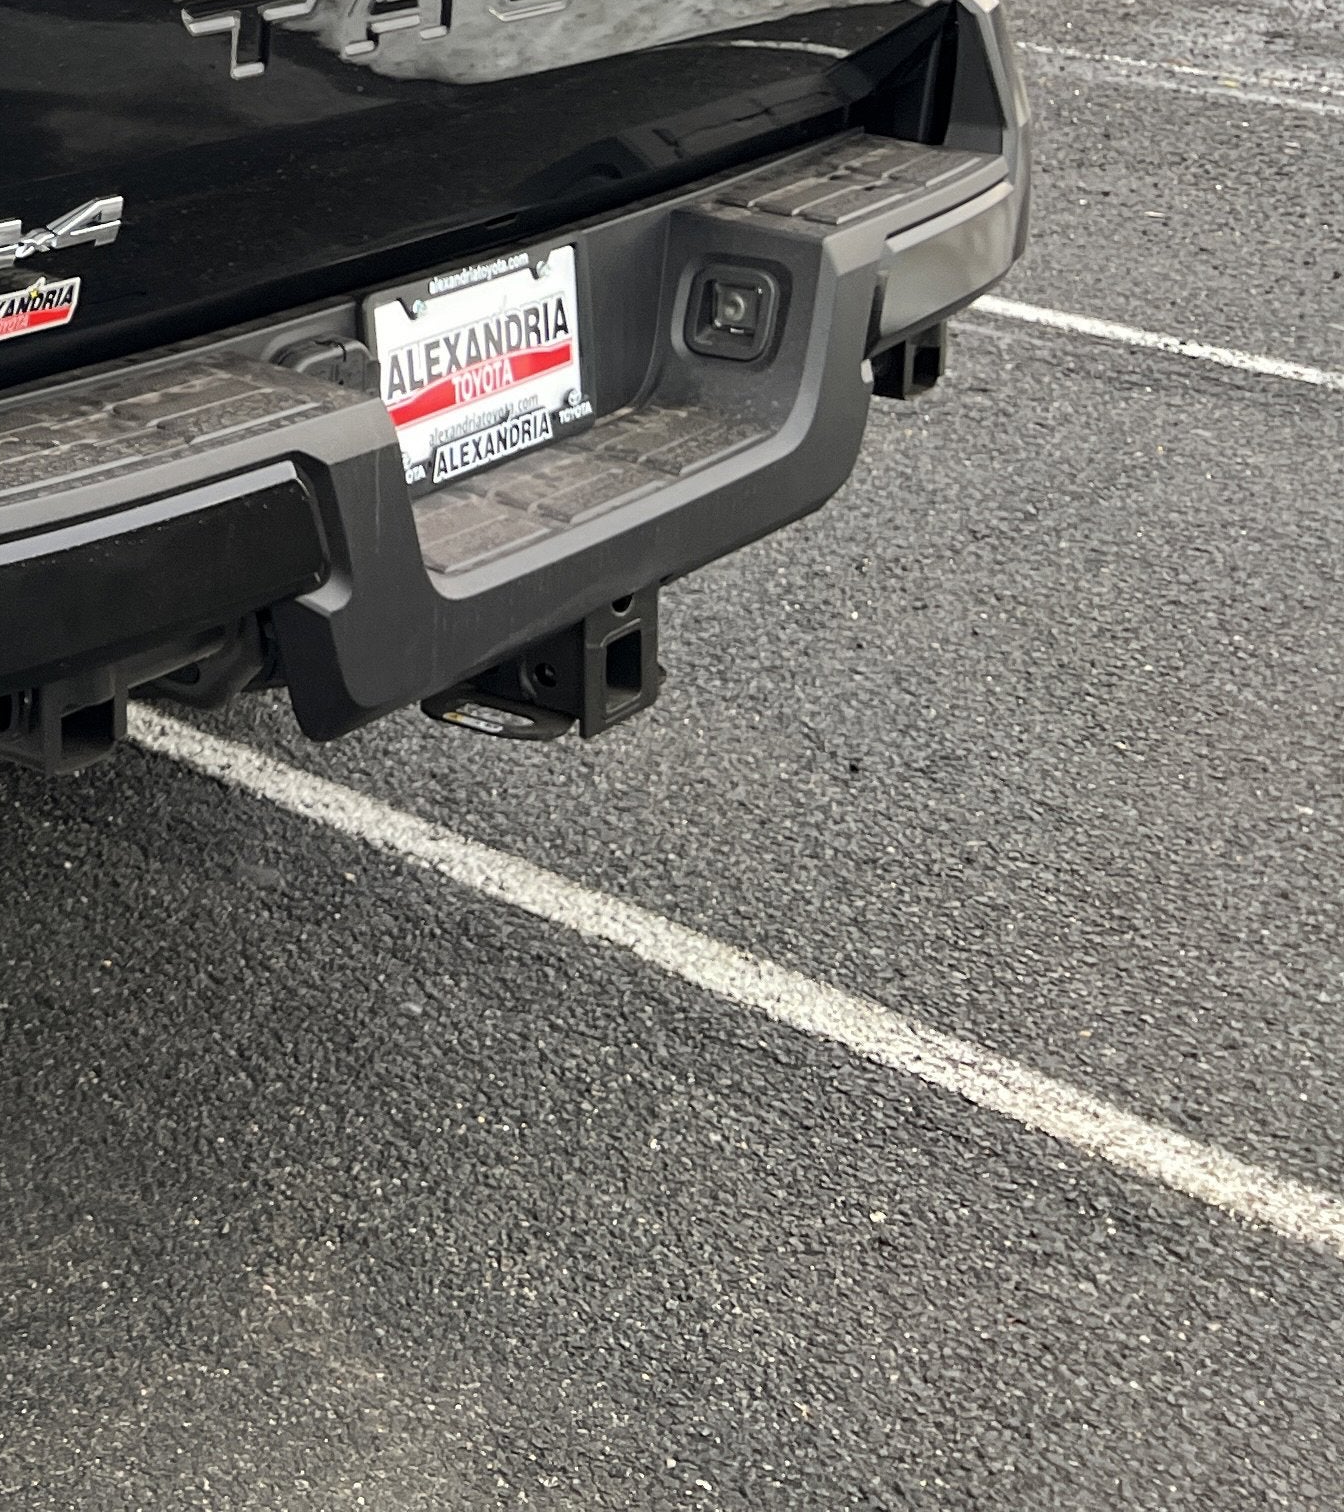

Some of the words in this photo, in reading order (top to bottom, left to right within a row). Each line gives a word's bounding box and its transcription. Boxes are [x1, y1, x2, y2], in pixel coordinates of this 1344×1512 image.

[428, 252, 529, 296] alexandriatoyota.com
[386, 296, 570, 401] ALEXANDRIA
[451, 359, 514, 405] TOYOTA
[428, 393, 539, 449] alexandriatoyota.com
[435, 414, 551, 479] ALEXANDRIA
